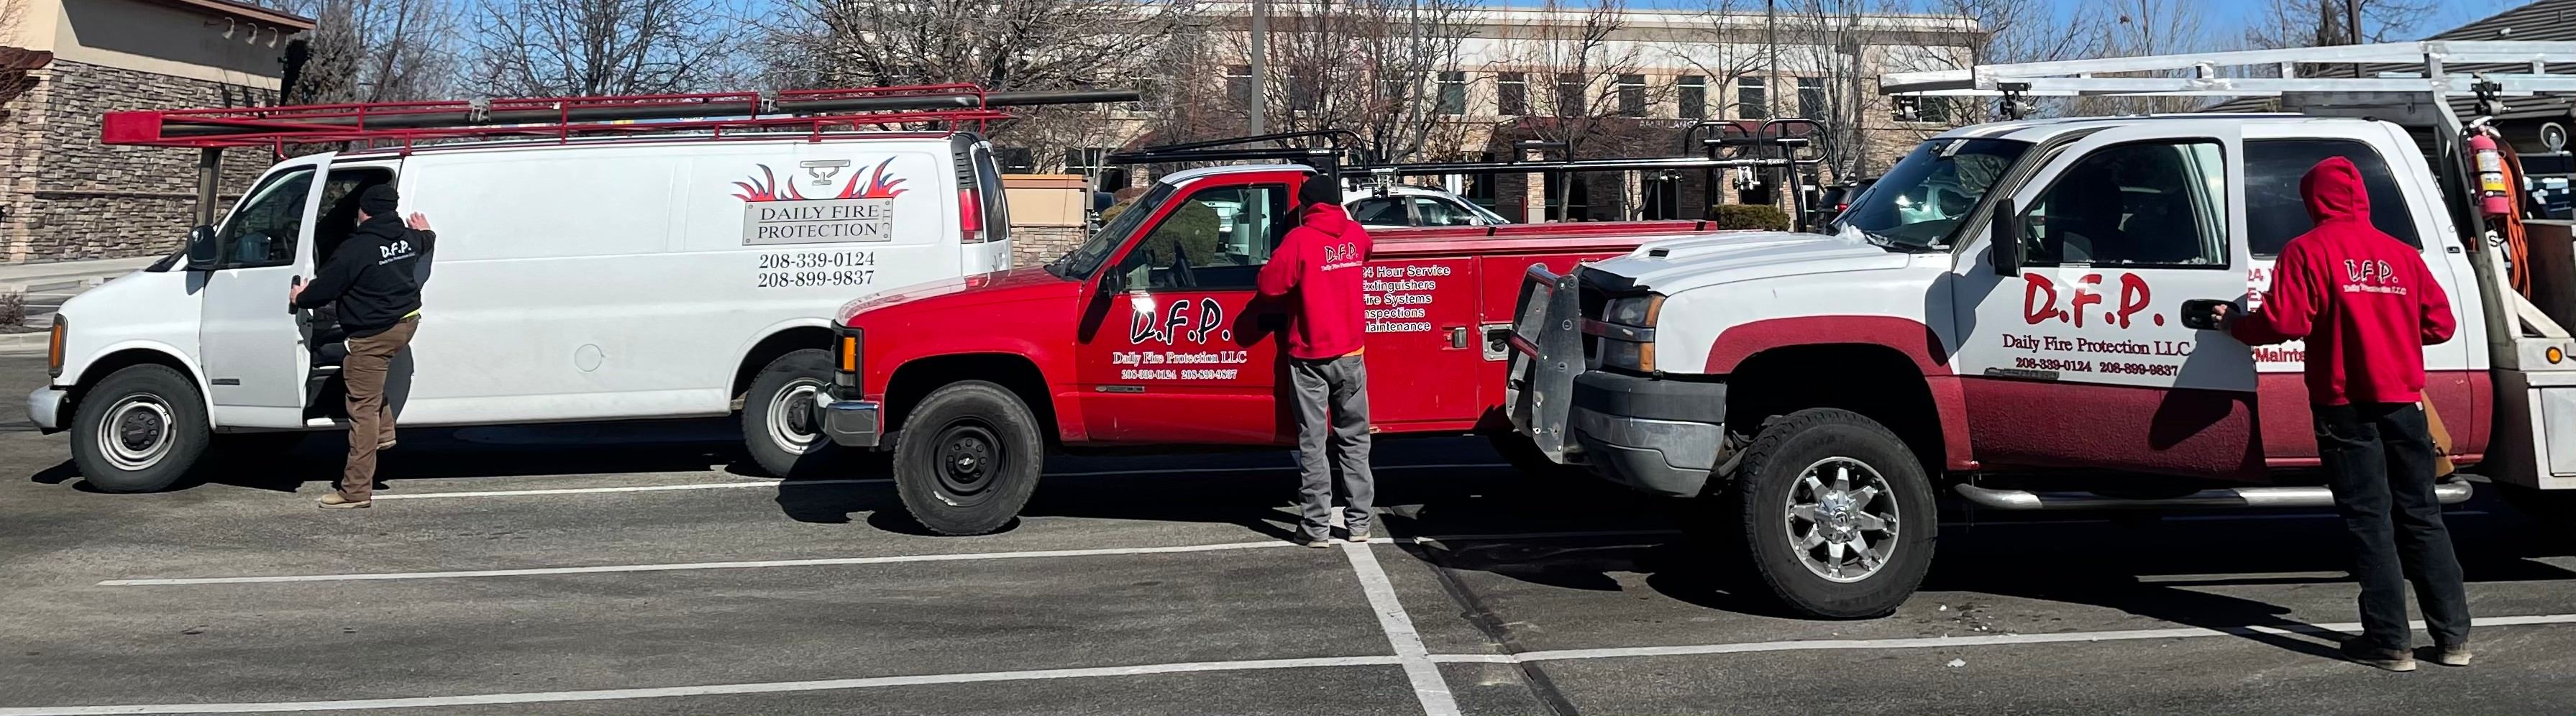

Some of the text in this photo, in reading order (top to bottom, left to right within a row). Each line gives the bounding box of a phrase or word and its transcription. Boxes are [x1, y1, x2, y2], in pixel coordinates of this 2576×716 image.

[761, 205, 880, 221] DAILY FIRE
[758, 223, 878, 239] PROTECTION
[379, 240, 411, 258] D.F.P.
[1324, 242, 1358, 263] D.F.P.
[759, 252, 875, 269] 208-339-0124
[758, 270, 874, 288] 208-899-9837
[1377, 266, 1405, 277] Hour
[1407, 265, 1451, 276] Service
[1363, 293, 1433, 307] ire Systems
[2024, 272, 2165, 329] D.F.P.
[1130, 298, 1230, 345] D.F.P.
[1364, 307, 1425, 321] nspections
[2002, 334, 2192, 357] Daily Fire Protection LLC
[1113, 350, 1247, 367] Daily Fire Protection LLC
[2016, 357, 2179, 377] 208-339-0124 208-899-9837
